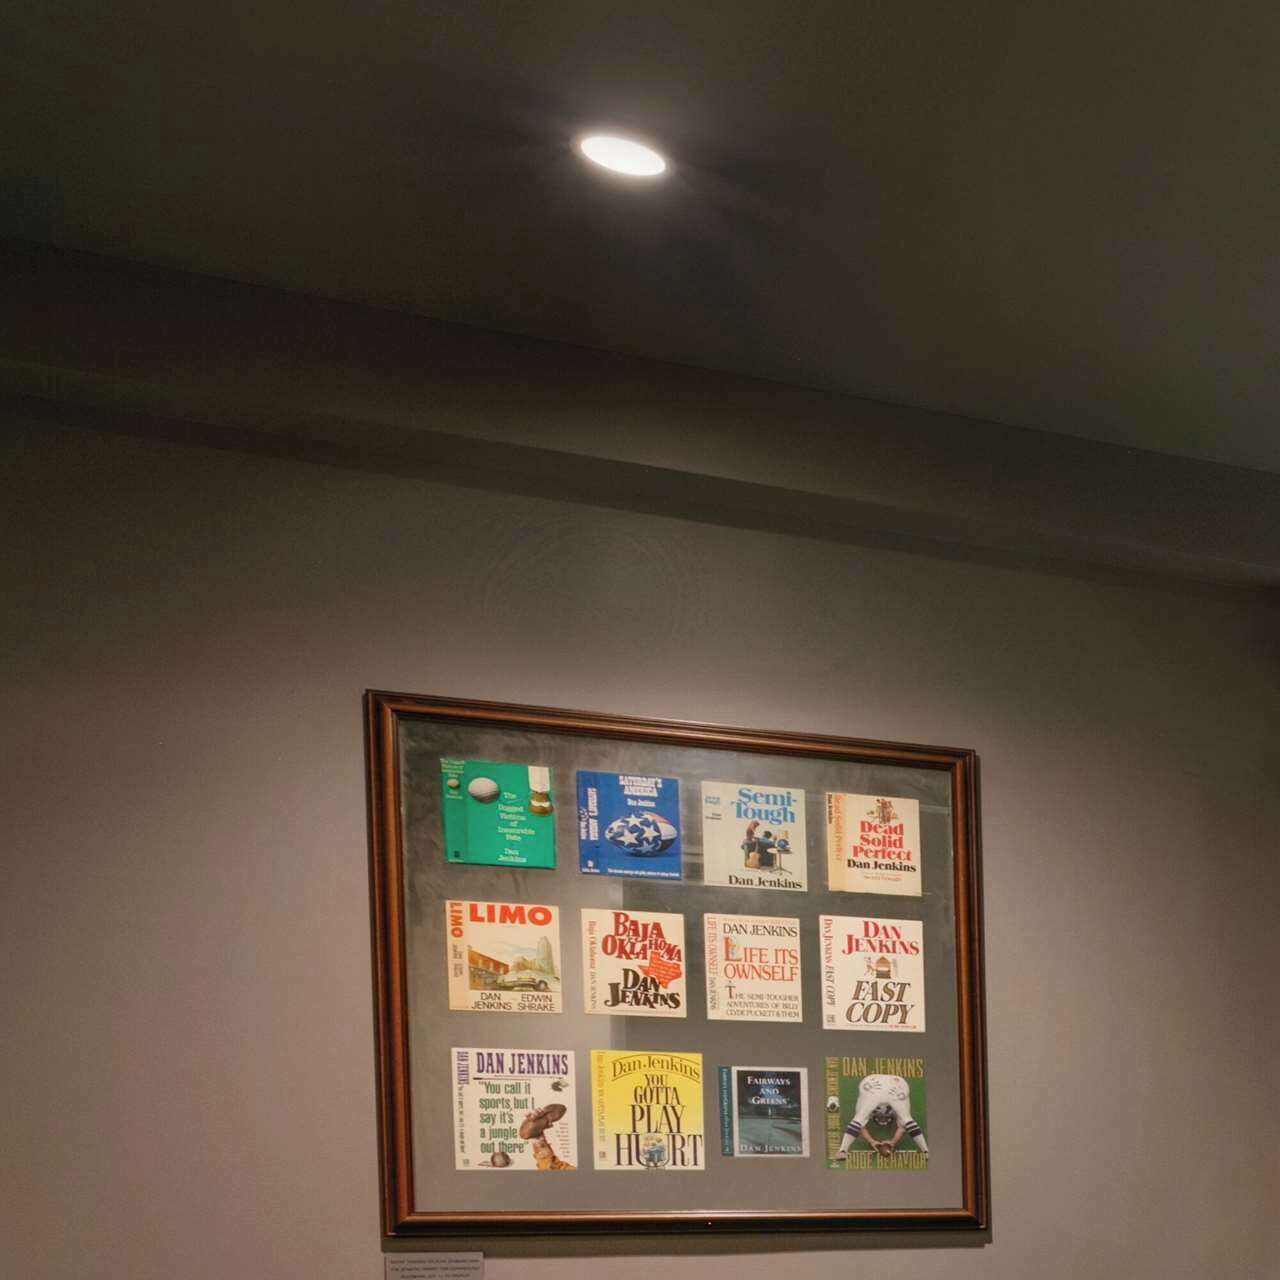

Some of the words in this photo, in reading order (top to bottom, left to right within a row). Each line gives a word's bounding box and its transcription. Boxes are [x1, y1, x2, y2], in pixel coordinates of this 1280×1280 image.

[738, 787, 797, 807] Semi-
[730, 799, 795, 825] Tough
[860, 820, 904, 836] Dead
[860, 834, 904, 849] Solid
[852, 845, 911, 861] Perfect
[847, 858, 870, 869] Dan
[872, 859, 917, 872] Jenkins
[729, 875, 753, 886] Dan
[755, 877, 802, 889] Jenkins
[449, 902, 464, 938] LIMO
[469, 903, 552, 926] LIMO
[613, 912, 665, 943] BAJA
[723, 923, 748, 935] DAN
[749, 924, 798, 937] JENKINS
[863, 920, 901, 940] DAN
[601, 934, 682, 962] OKLAHOMA
[724, 936, 769, 963] LIFE
[774, 948, 799, 965] ITS
[842, 934, 920, 955] JENKINS
[724, 963, 799, 981] OWNSELF
[622, 968, 661, 993] DAN
[480, 992, 501, 1001] DAN
[521, 993, 552, 1003] EDWIN
[604, 982, 681, 1009] JENKINS
[852, 980, 911, 1002] FAST
[471, 1002, 512, 1010] JENKINS
[518, 1003, 555, 1012] SHRAKE
[845, 1001, 914, 1024] COPY
[476, 1052, 504, 1074] DAN
[509, 1053, 568, 1075] JENKINS
[611, 1059, 641, 1078] Dan
[643, 1056, 700, 1079] Jenkins
[843, 1057, 867, 1076] DAN
[872, 1057, 924, 1077] JENKINS
[504, 1082, 521, 1094] call
[525, 1083, 531, 1094] it
[645, 1074, 668, 1087] YOU
[747, 1076, 791, 1086] FAIRWAYS
[634, 1085, 680, 1105] GOTTA
[760, 1087, 780, 1095] AND
[480, 1097, 513, 1111] sports,
[514, 1098, 528, 1109] but
[752, 1096, 788, 1105] GREENS
[480, 1114, 496, 1125] say
[500, 1113, 513, 1124] it's
[630, 1104, 686, 1133] PLAY
[480, 1129, 486, 1138] a
[488, 1127, 518, 1140] jungle
[481, 1143, 495, 1153] out
[615, 1133, 702, 1168] HURT
[741, 1143, 762, 1152] DAN
[764, 1144, 802, 1153] JENKINS
[846, 1152, 873, 1168] RUDE
[876, 1152, 928, 1168] BEHAVIOR
